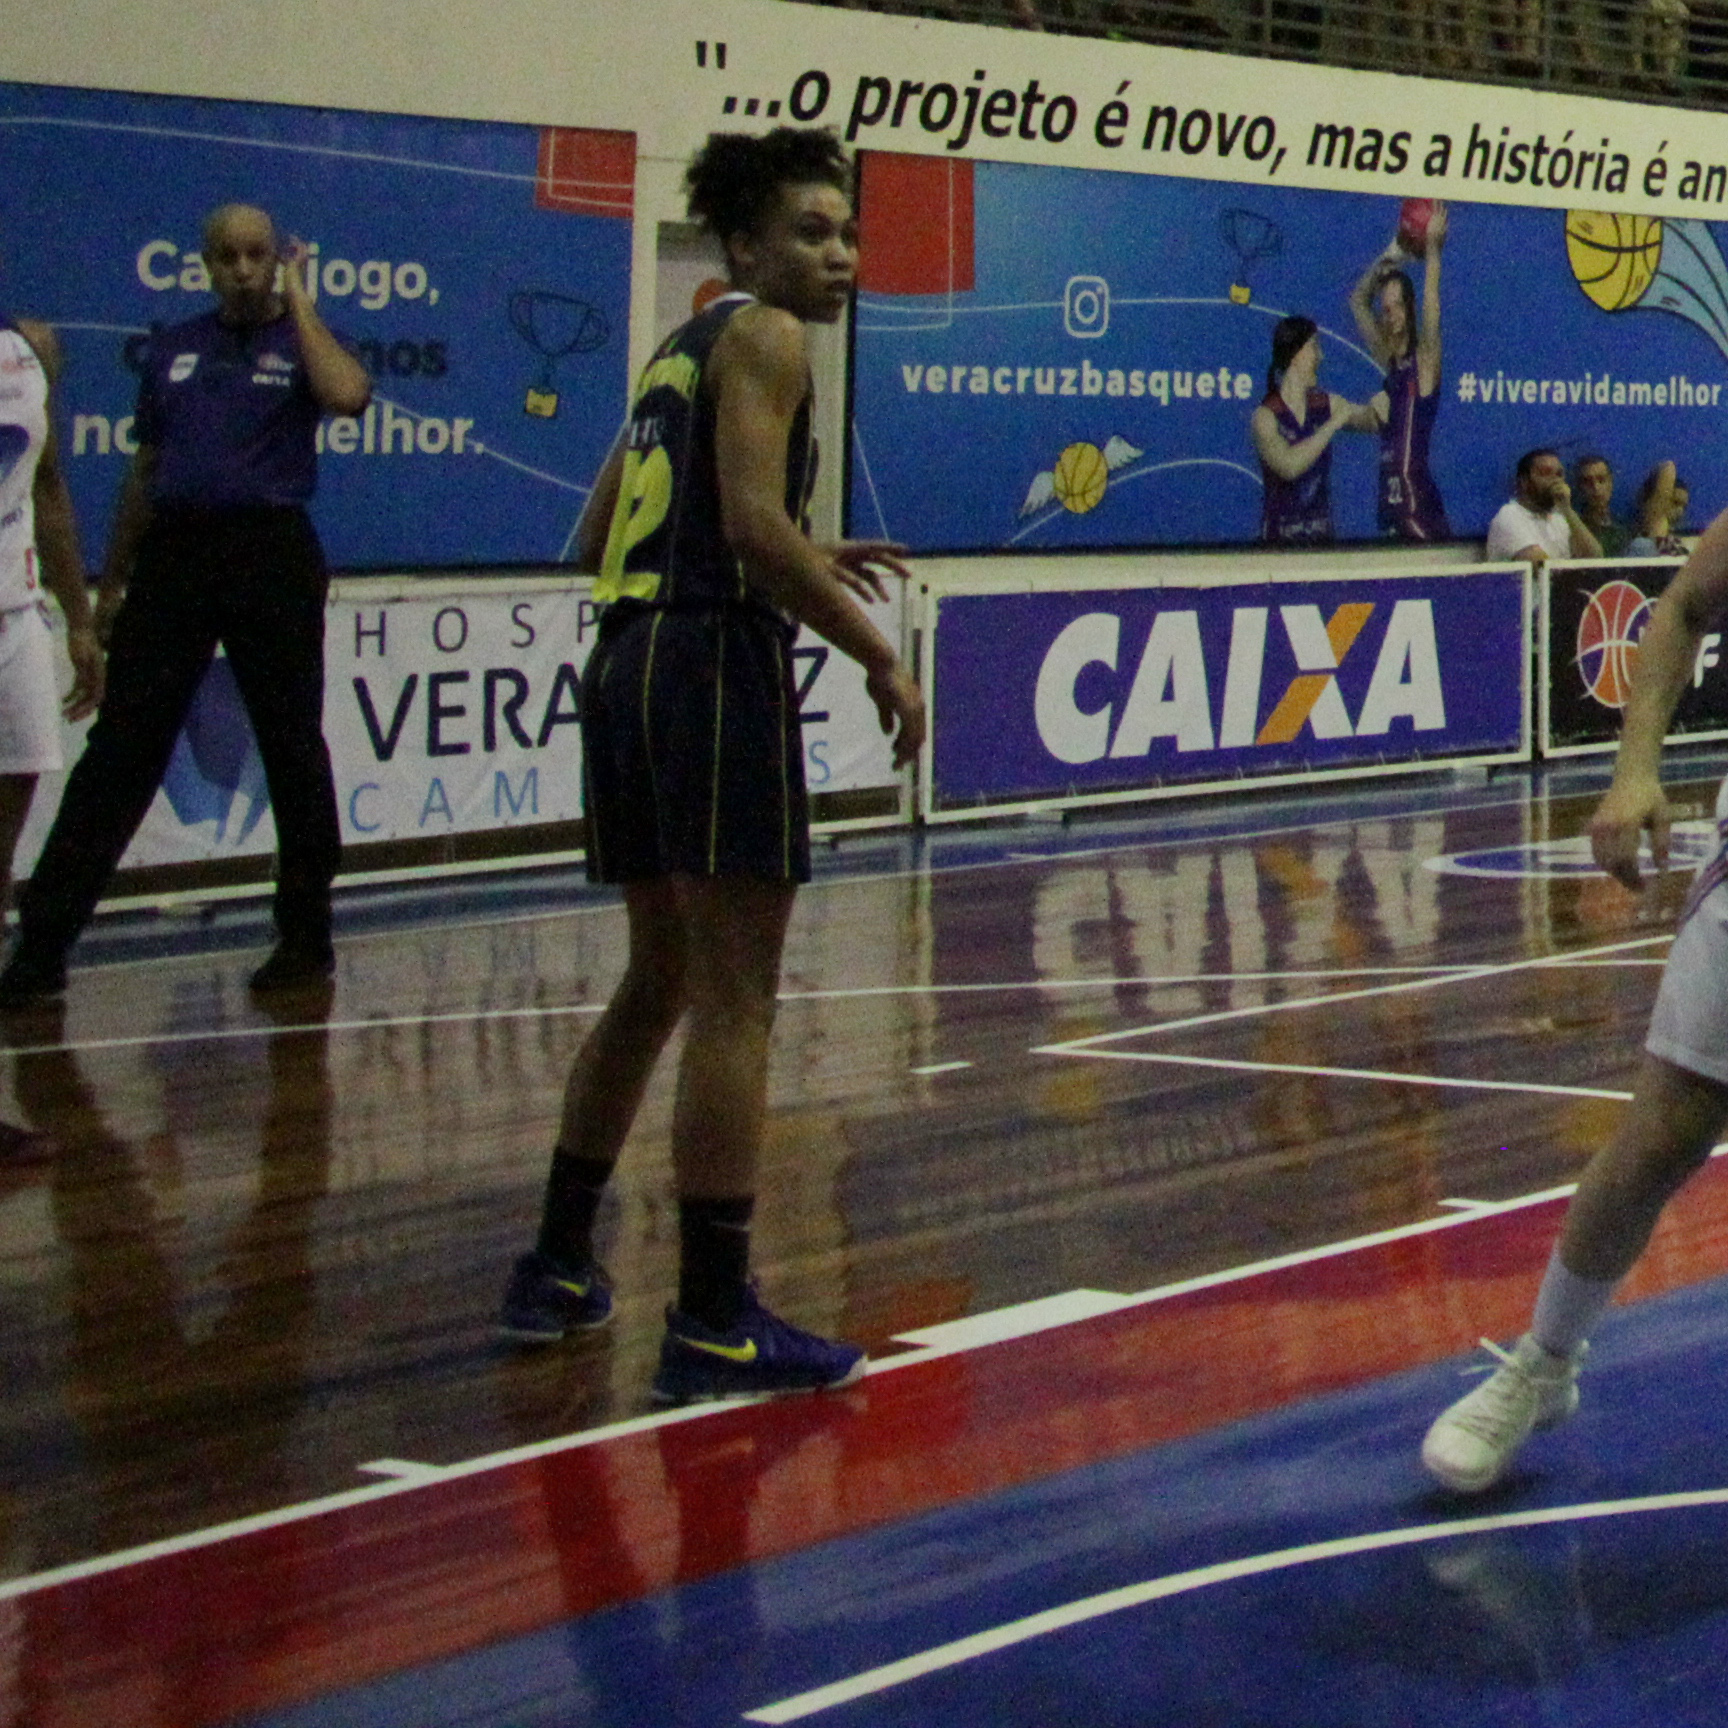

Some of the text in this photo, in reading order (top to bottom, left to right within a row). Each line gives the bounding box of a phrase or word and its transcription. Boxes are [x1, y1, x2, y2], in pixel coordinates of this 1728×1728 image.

[845, 70, 1078, 150] projeto
[1094, 81, 1130, 149] é
[1142, 106, 1287, 175] novo,
[1306, 121, 1411, 174] mas
[1423, 134, 1452, 177] a
[1463, 123, 1630, 194] história
[1643, 141, 1668, 197] é
[305, 243, 440, 310] jogo,
[901, 359, 1253, 406] veracruzbasquete
[1457, 371, 1722, 408] #viveravidamelhor
[353, 665, 585, 762] VERA
[1034, 599, 1447, 764] CAIXA
